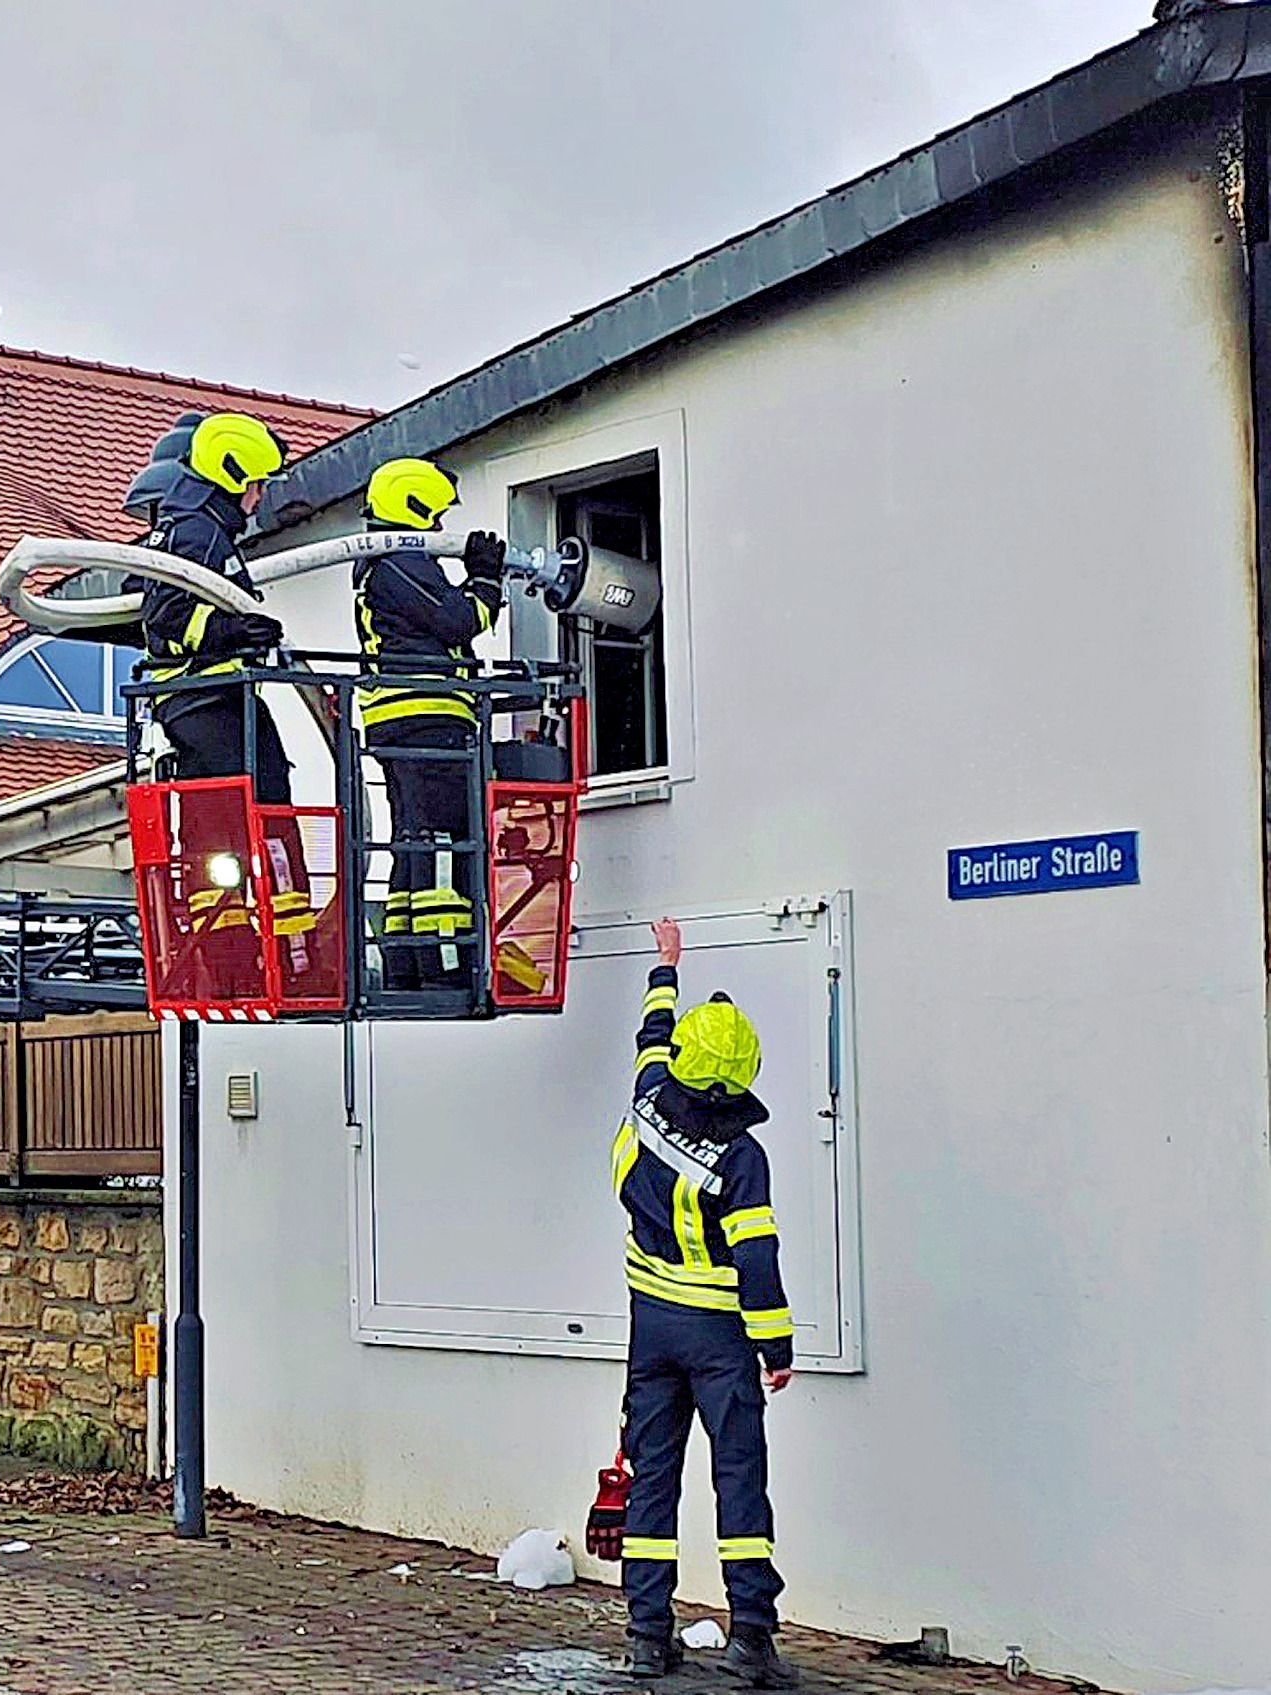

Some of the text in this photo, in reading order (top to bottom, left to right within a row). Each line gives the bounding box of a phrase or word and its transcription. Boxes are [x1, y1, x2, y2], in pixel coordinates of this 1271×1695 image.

[959, 841, 1122, 886] Berliner Straße
[665, 1132, 720, 1168] ALLER
